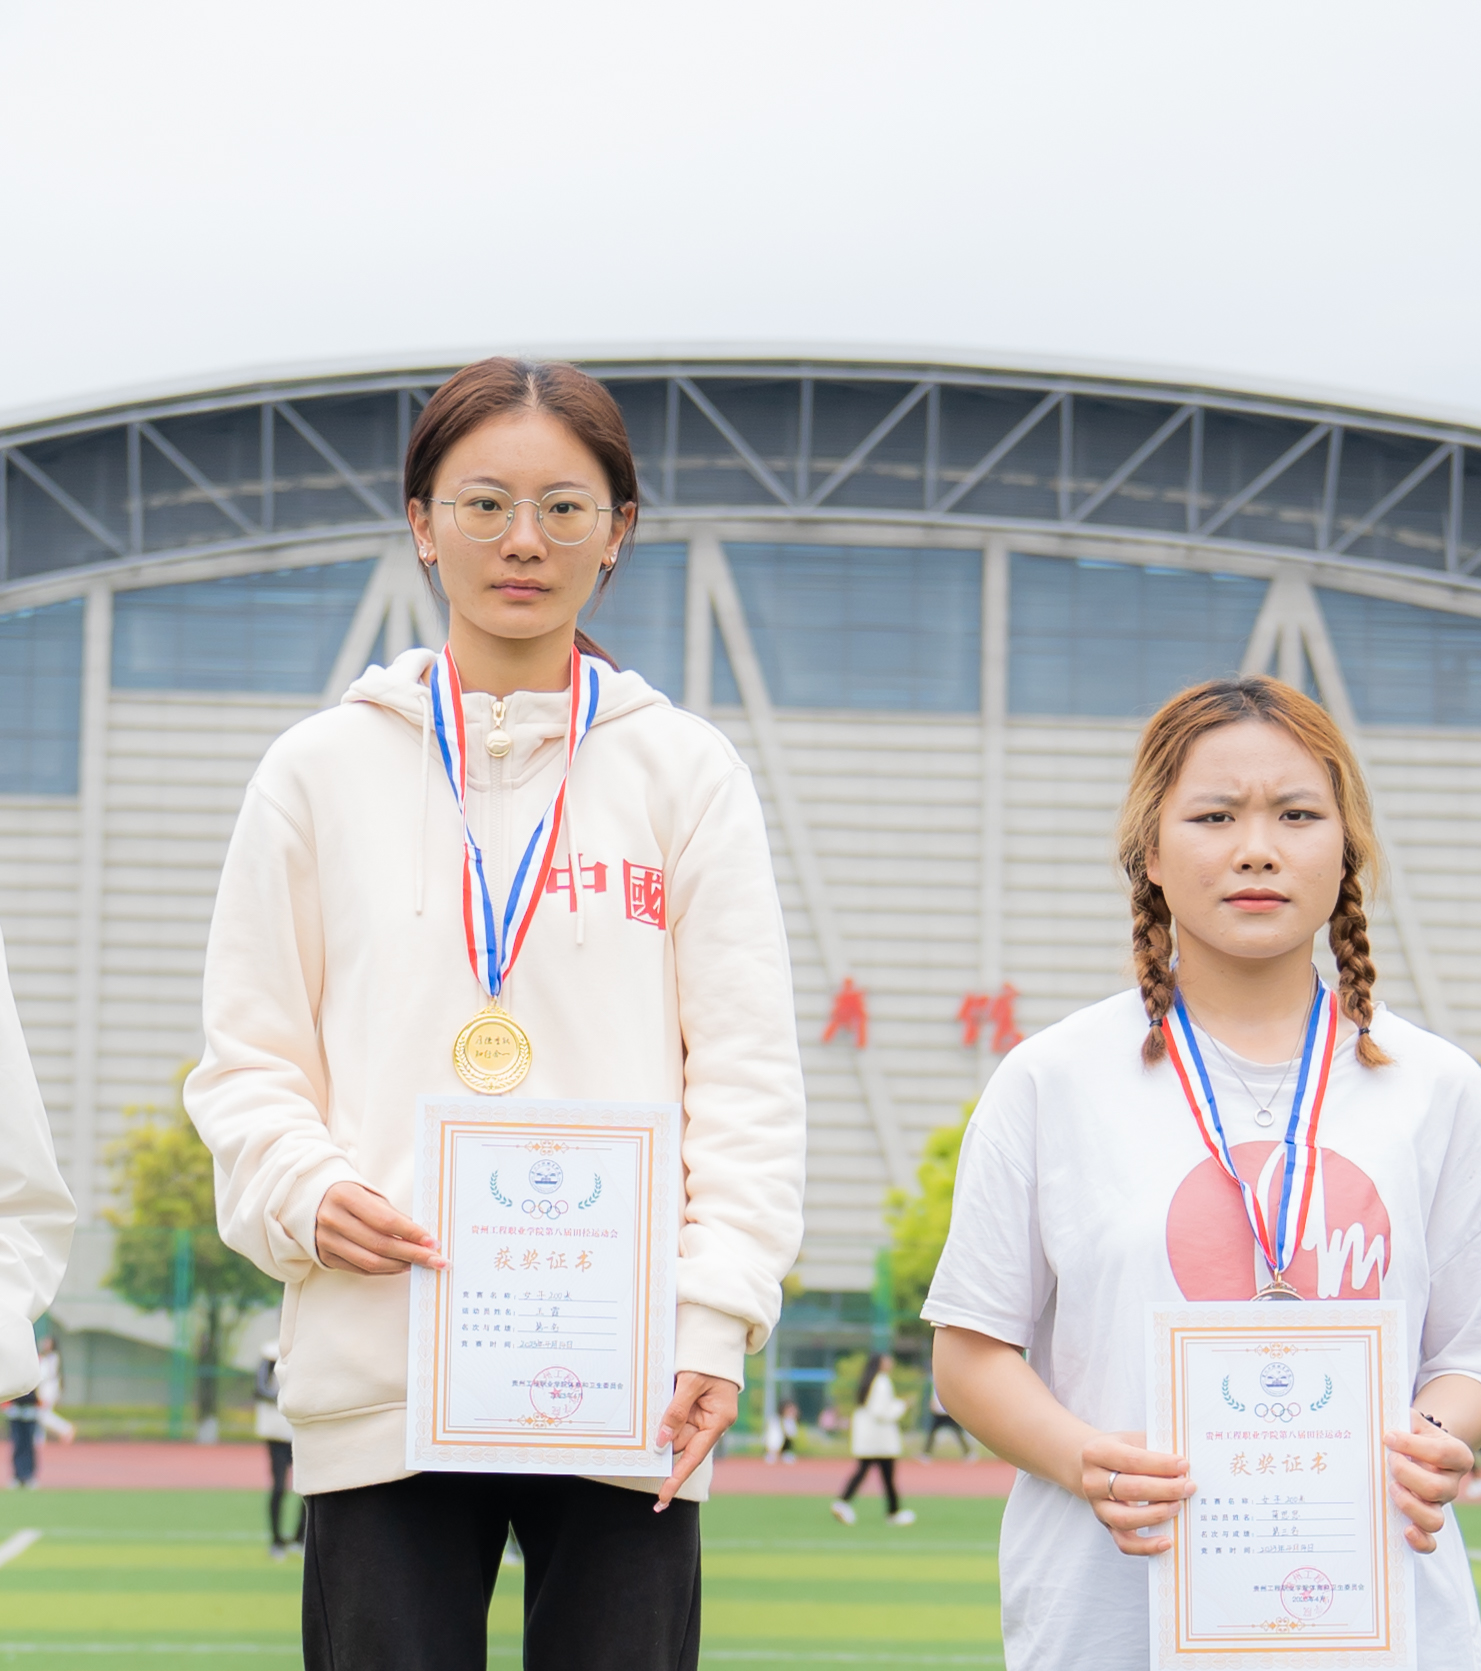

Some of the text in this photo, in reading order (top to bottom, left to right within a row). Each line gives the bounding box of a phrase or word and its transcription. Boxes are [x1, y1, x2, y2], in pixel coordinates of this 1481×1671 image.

[494, 1246, 594, 1273] 获奖证书
[1229, 1451, 1328, 1477] 获奖证书
